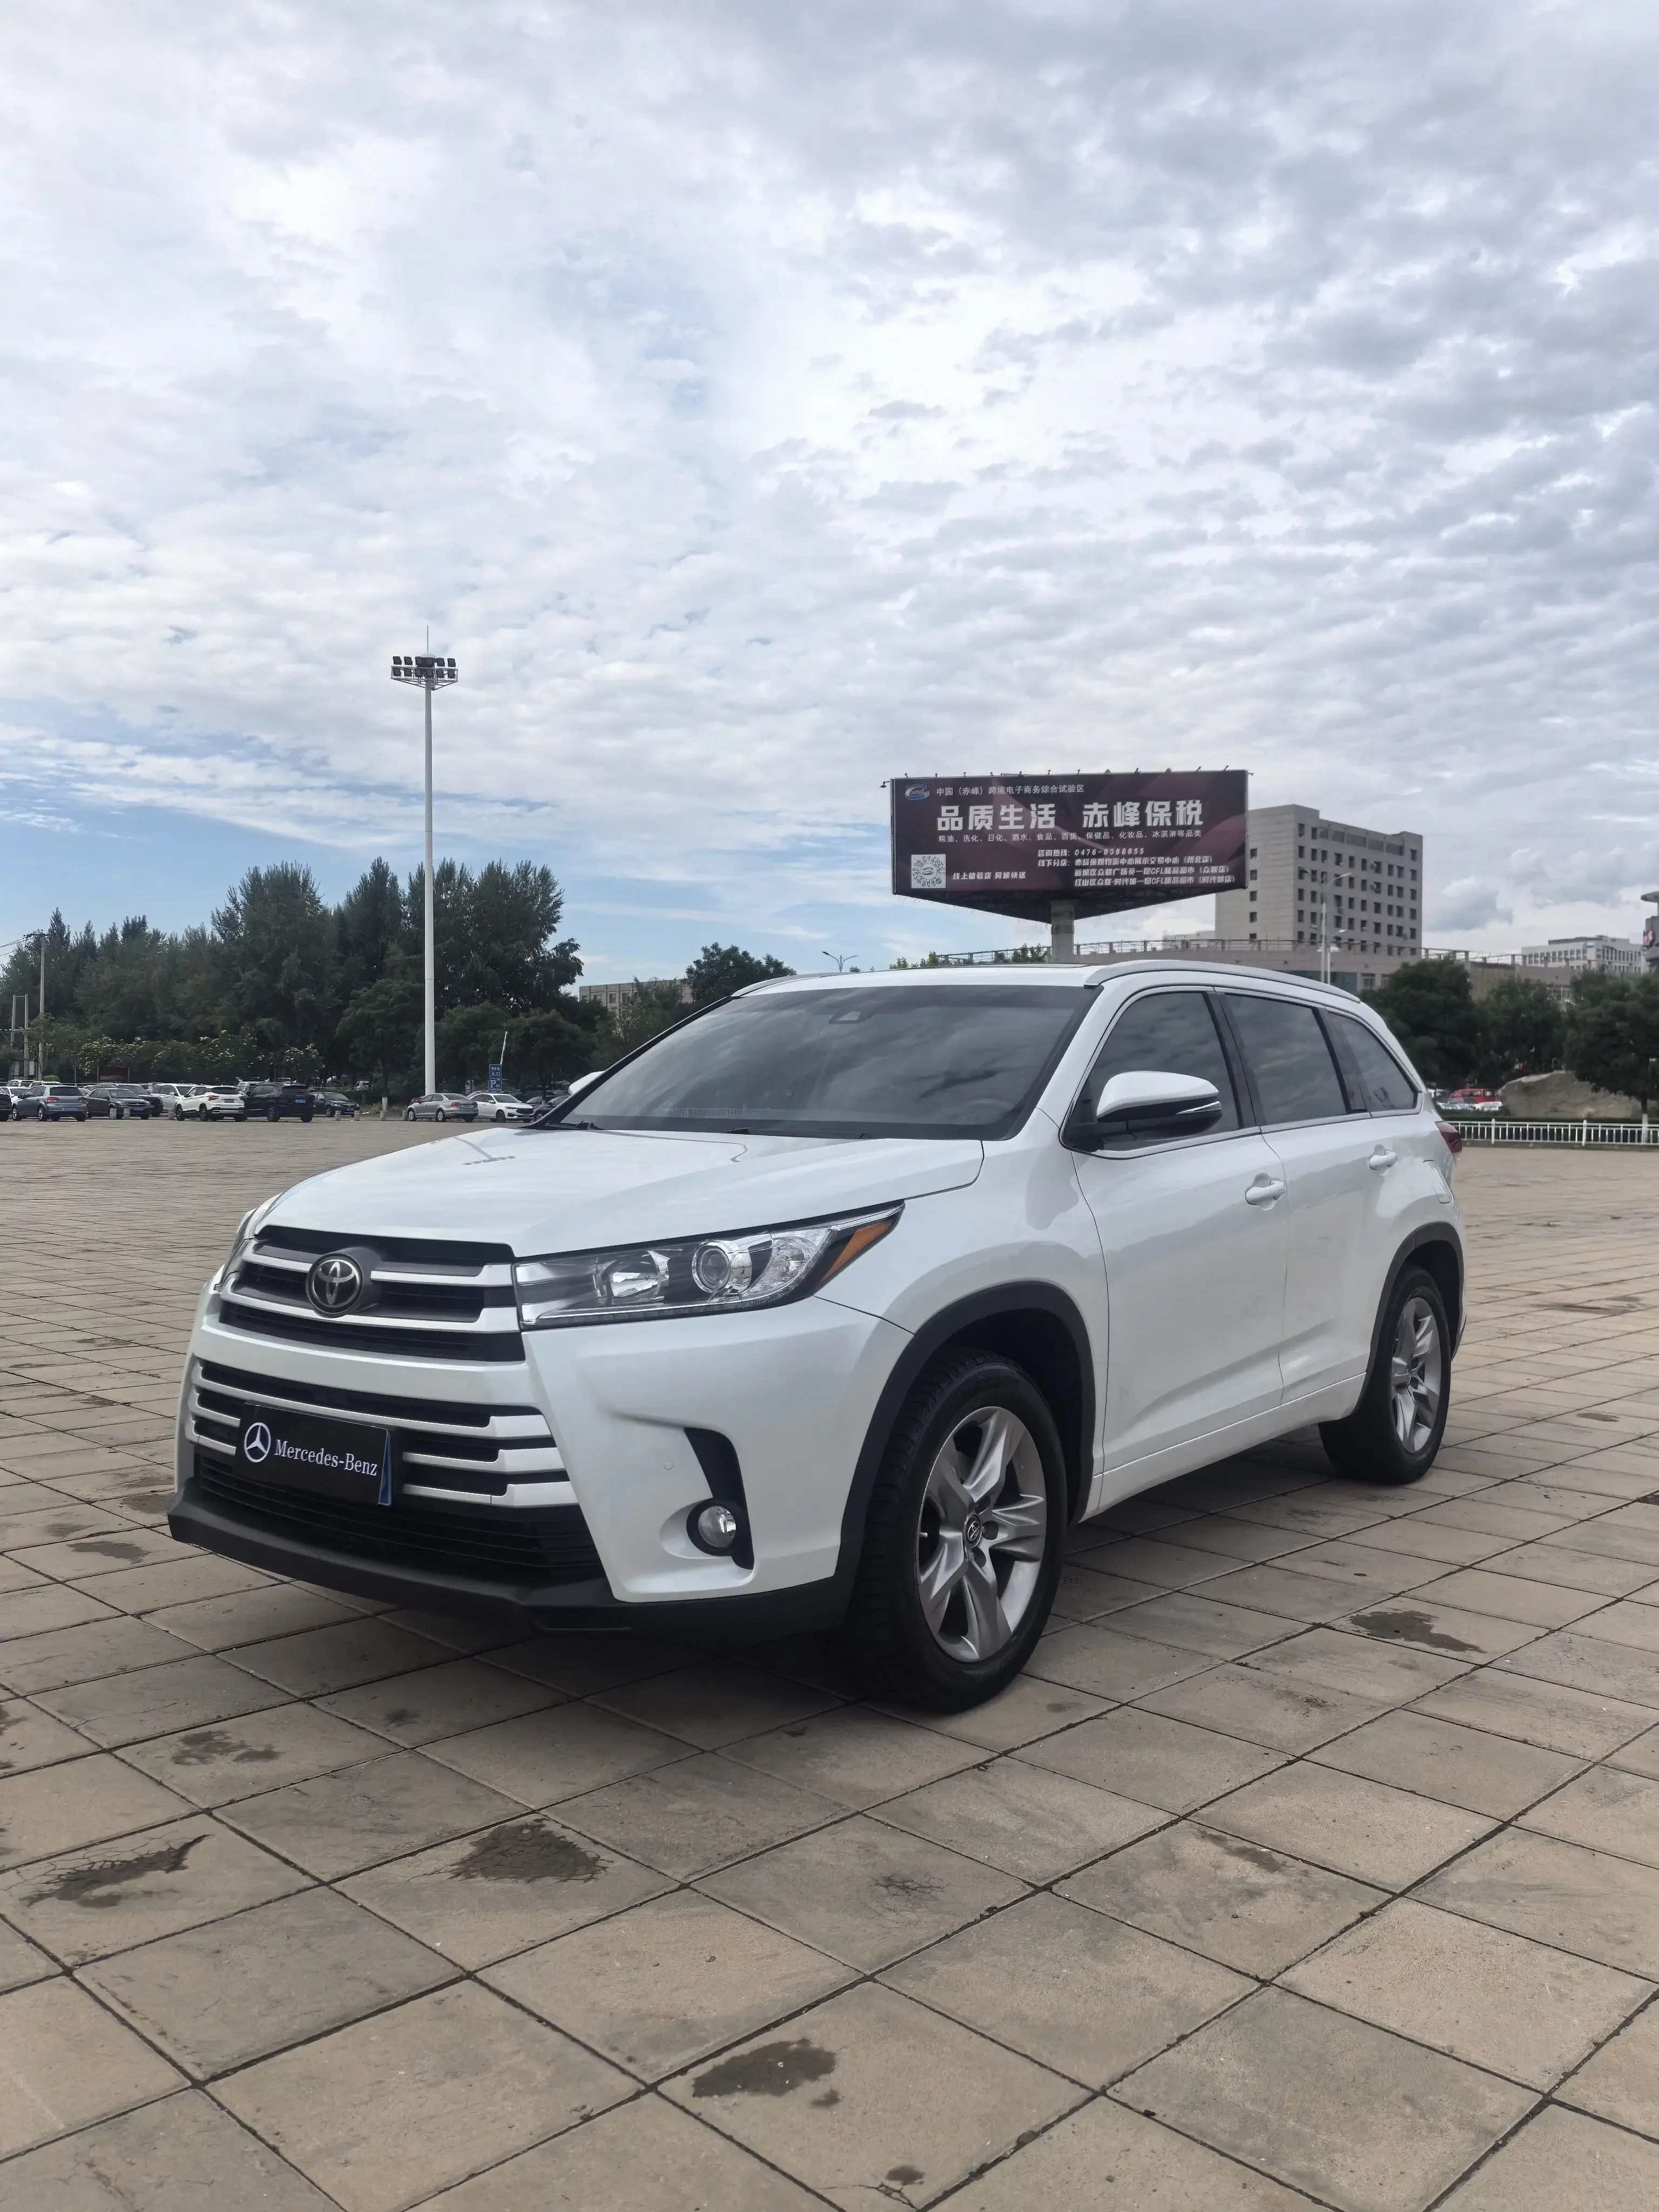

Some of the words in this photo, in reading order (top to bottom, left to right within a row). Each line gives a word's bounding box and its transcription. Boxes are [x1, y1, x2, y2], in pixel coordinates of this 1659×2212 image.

[937, 785, 1084, 796] 中国（赤峰）跨境电子商务综合试验区
[937, 803, 1056, 831] 品质生活
[1082, 800, 1203, 828] 赤峰保税
[274, 1439, 377, 1476] Mercedes-Benz
